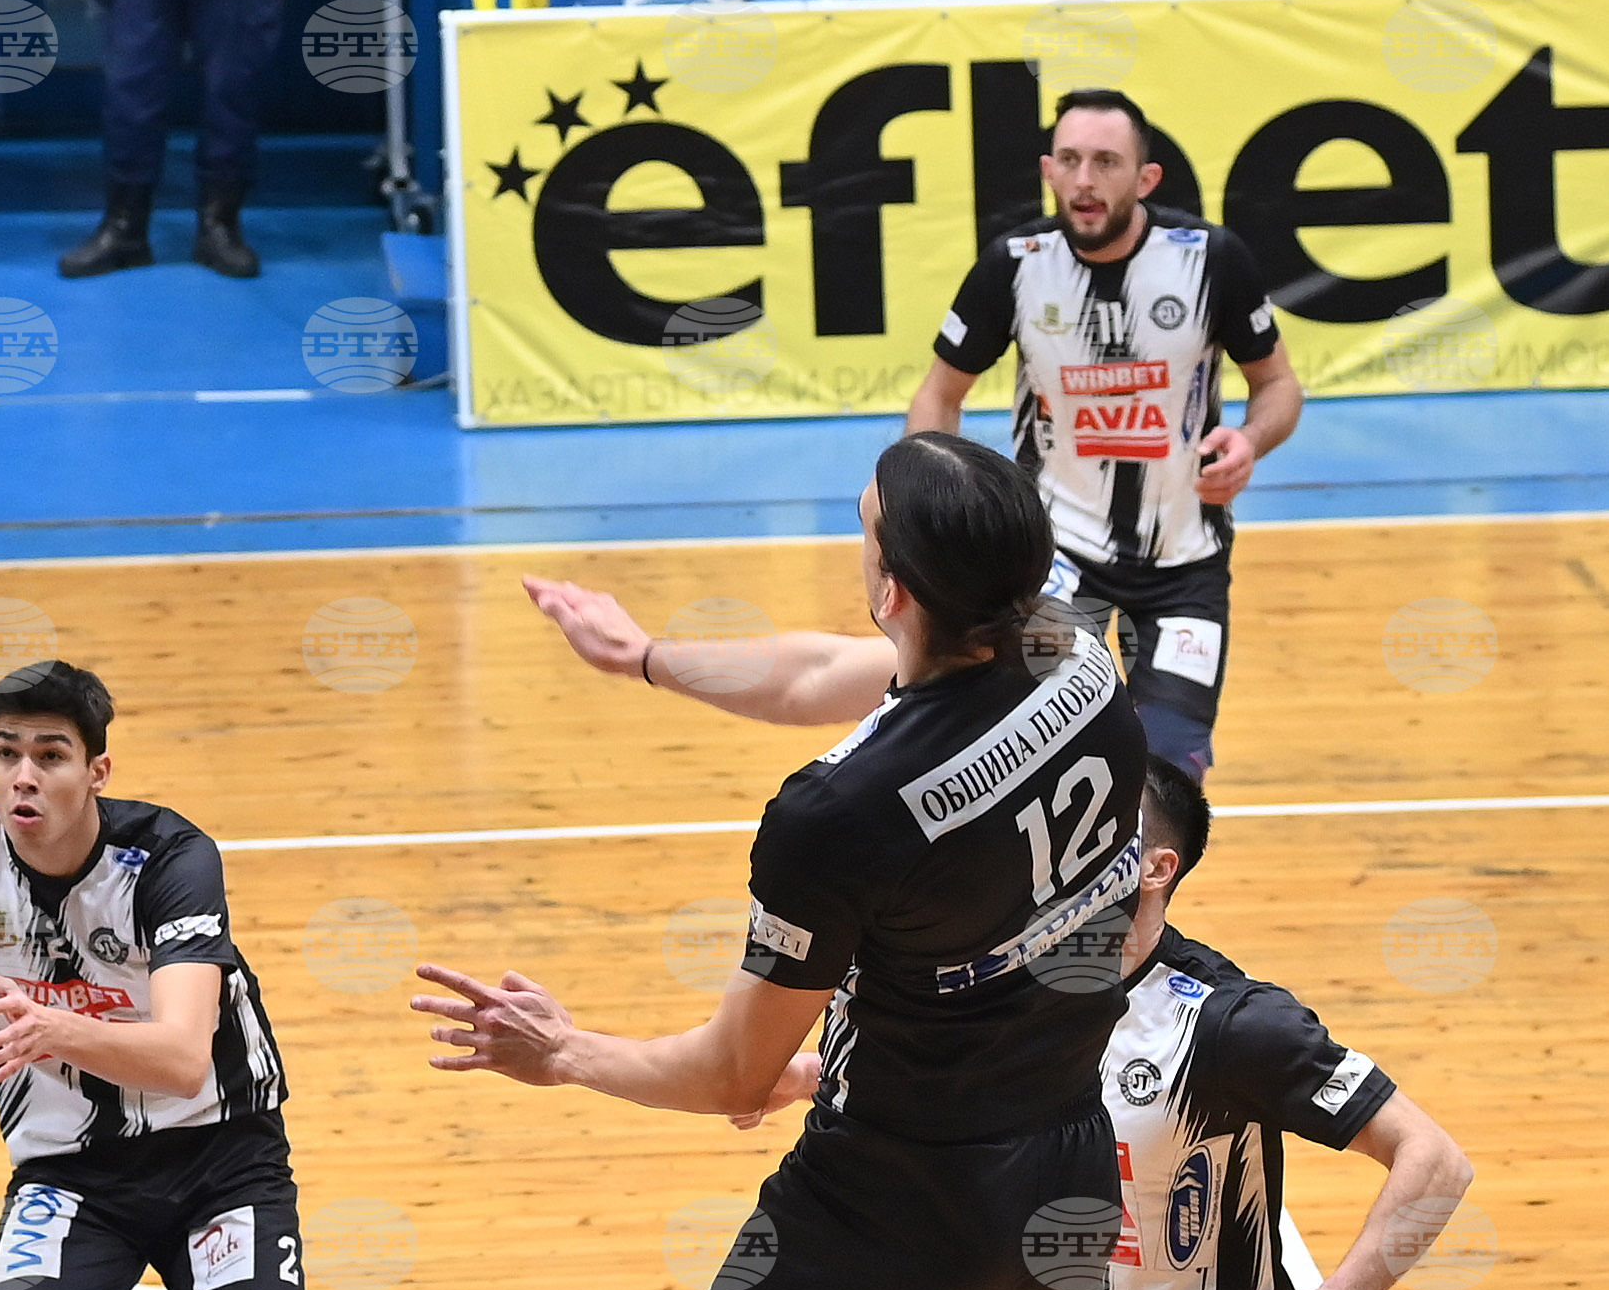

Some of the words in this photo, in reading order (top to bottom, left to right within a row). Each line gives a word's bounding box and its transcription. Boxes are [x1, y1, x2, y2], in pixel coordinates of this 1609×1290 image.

[533, 46, 1609, 348] efbet
[1065, 364, 1166, 389] WINBET
[920, 729, 1036, 823] ОБЩИНА
[1015, 755, 1118, 907] 12
[277, 1235, 299, 1286] 2
